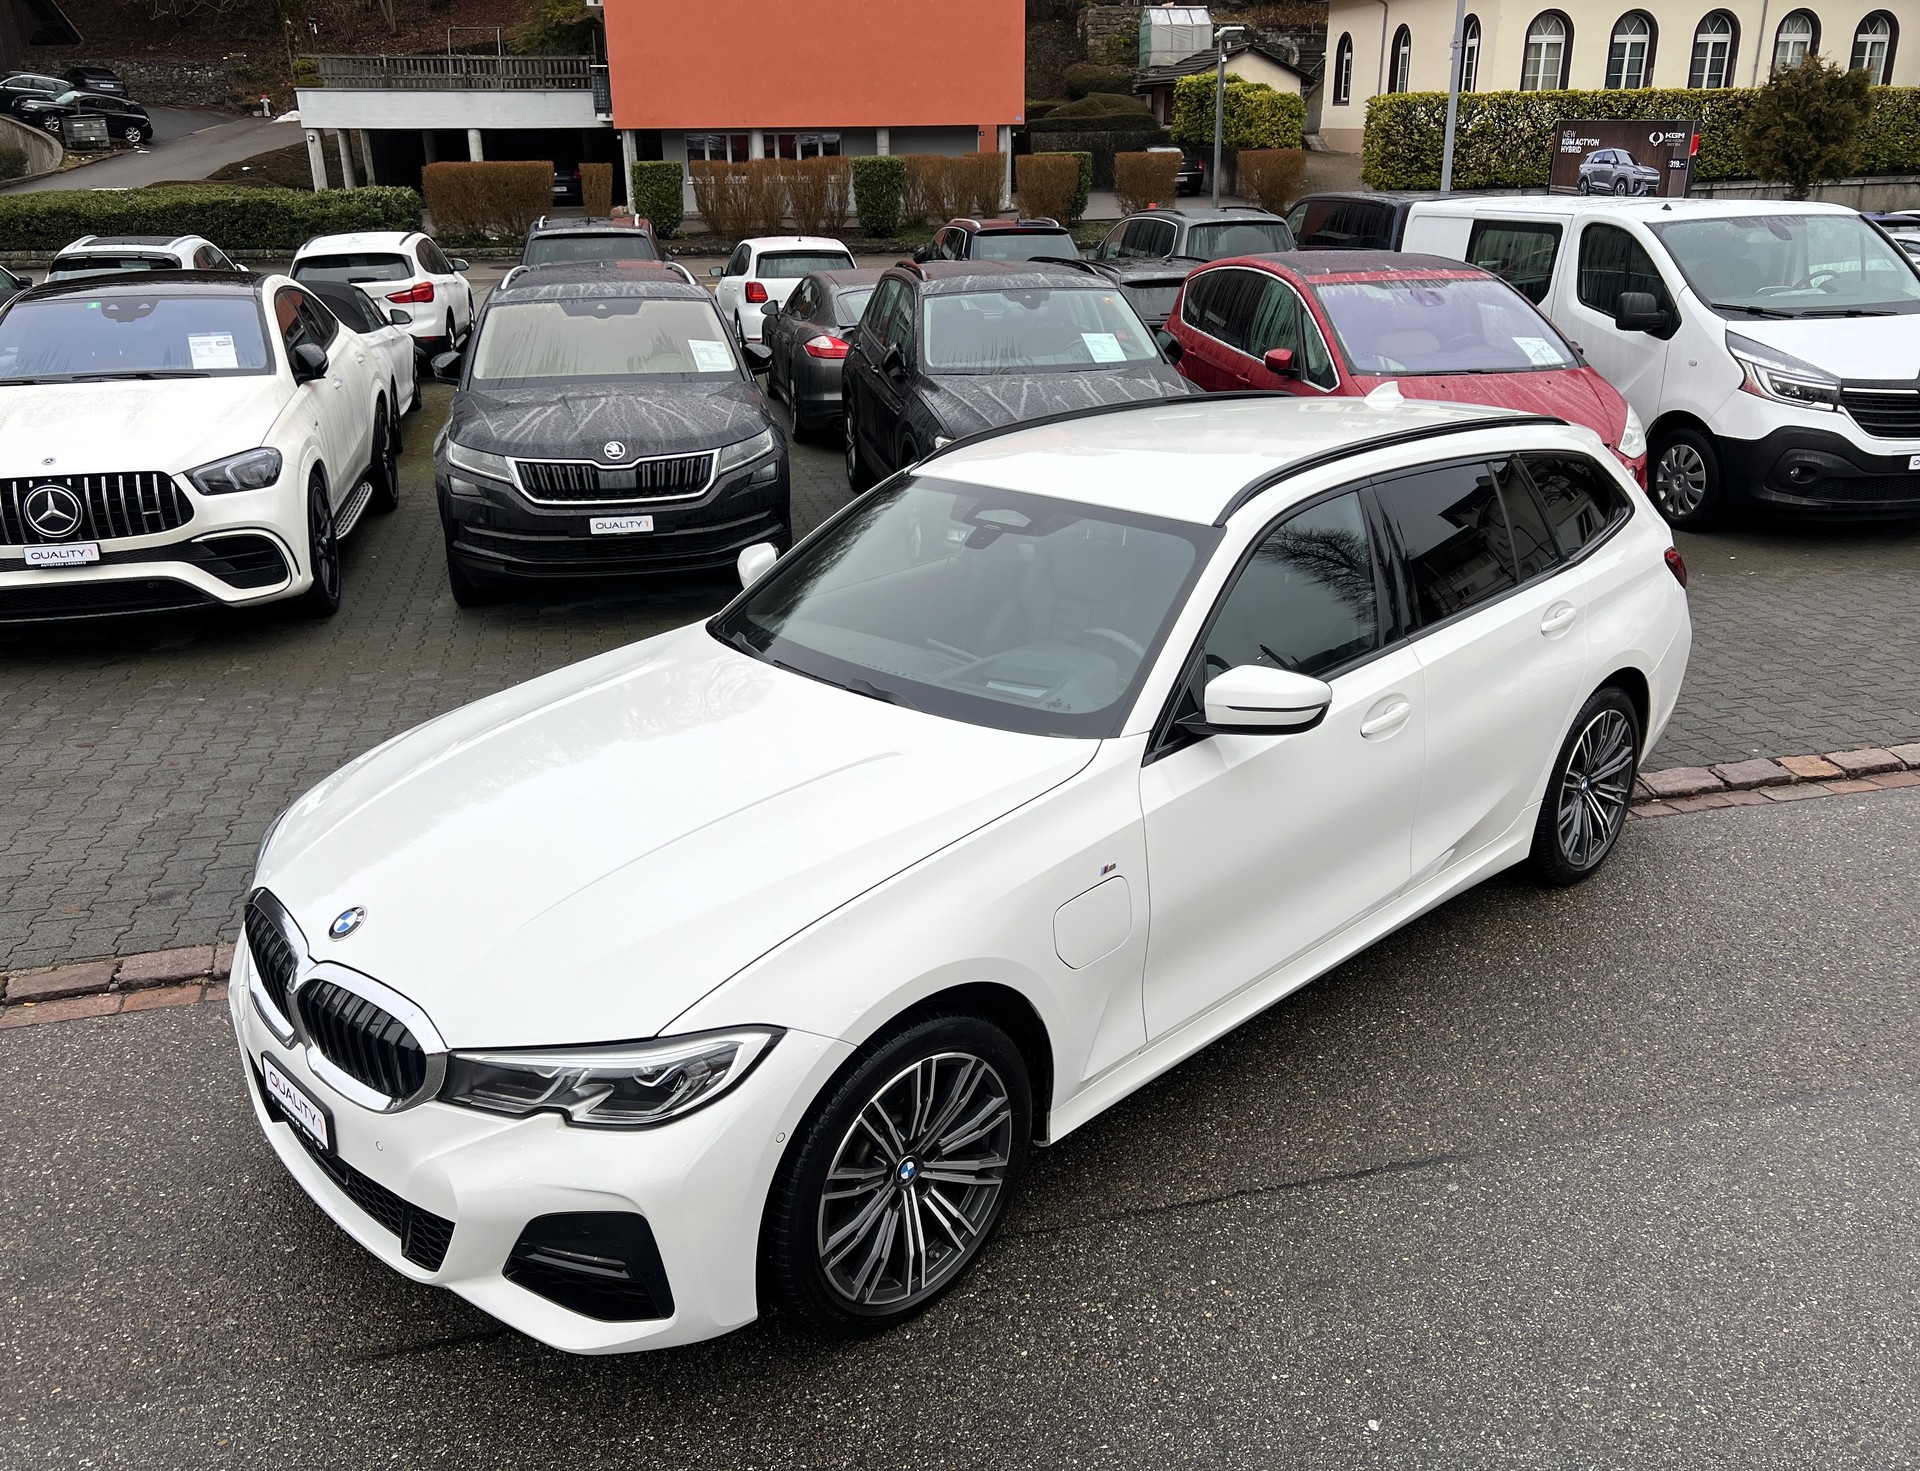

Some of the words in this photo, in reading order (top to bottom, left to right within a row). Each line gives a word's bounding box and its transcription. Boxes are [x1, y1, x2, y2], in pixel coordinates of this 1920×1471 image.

[1562, 138, 1575, 146] KGM
[1575, 138, 1599, 146] ACTYON
[596, 521, 642, 529] QUALITY
[31, 550, 85, 559] QUALITY
[270, 1071, 316, 1126] QUALITY
[318, 1118, 323, 1135] 1
